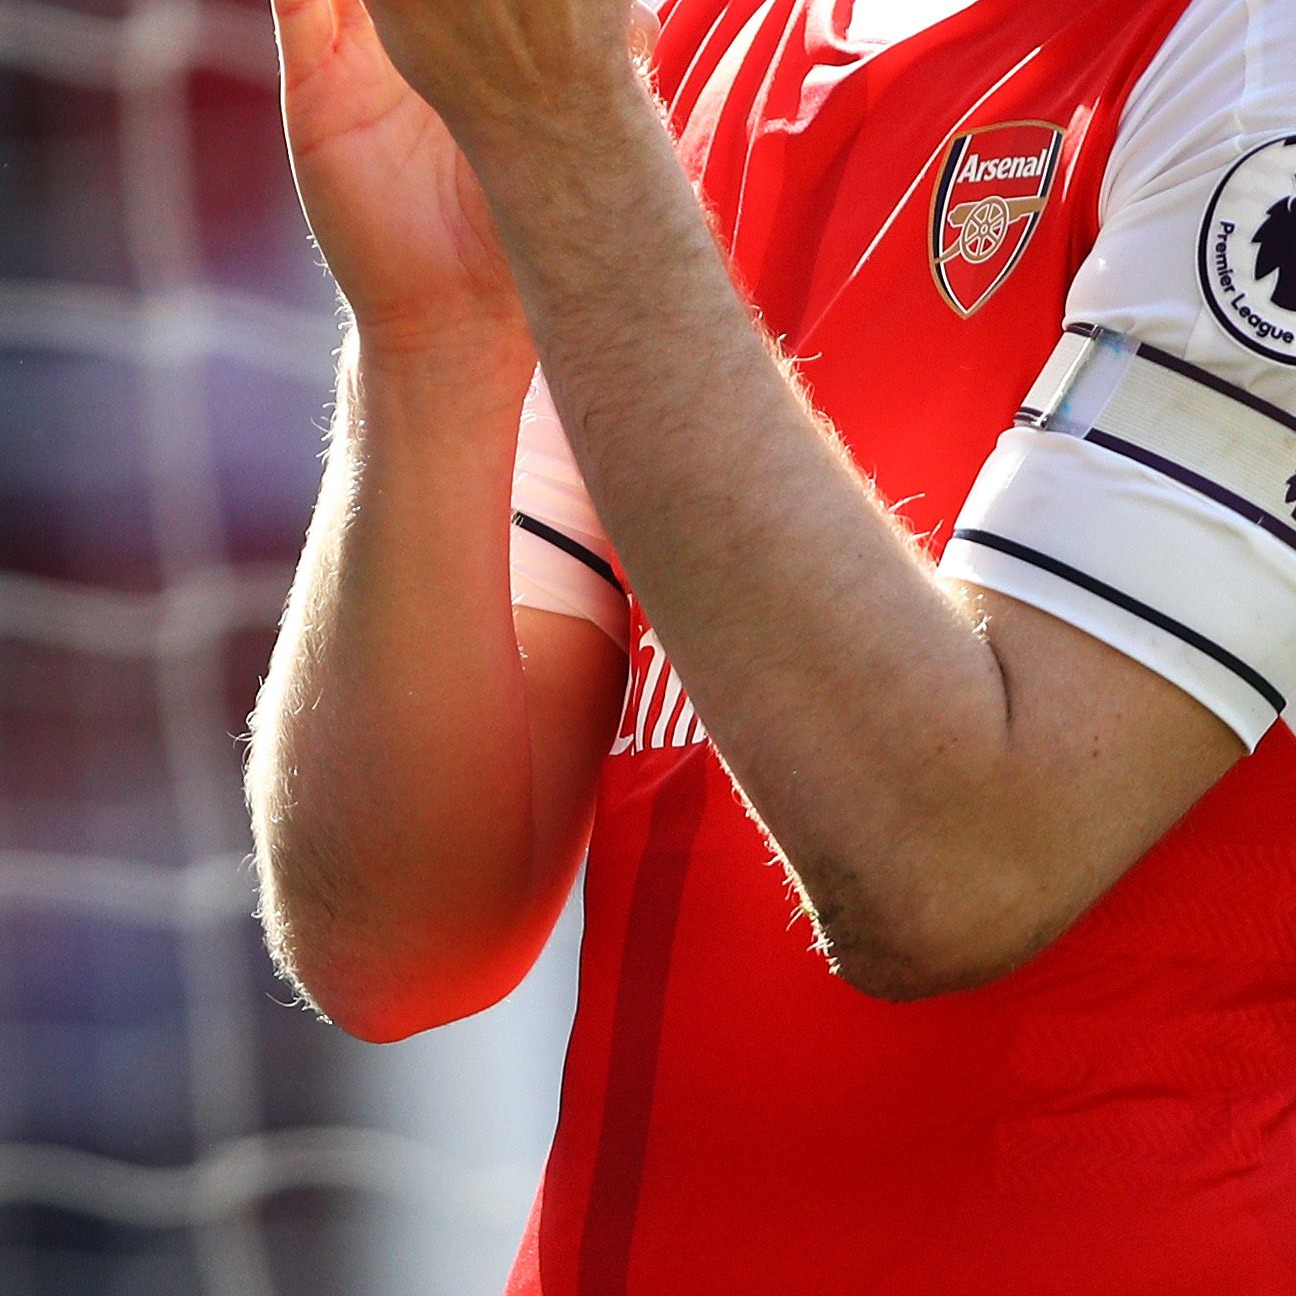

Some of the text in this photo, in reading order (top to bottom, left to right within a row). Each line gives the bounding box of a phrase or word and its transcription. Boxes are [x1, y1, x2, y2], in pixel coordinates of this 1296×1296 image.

[956, 149, 1048, 184] Arsenal
[1215, 220, 1295, 344] Premier League
